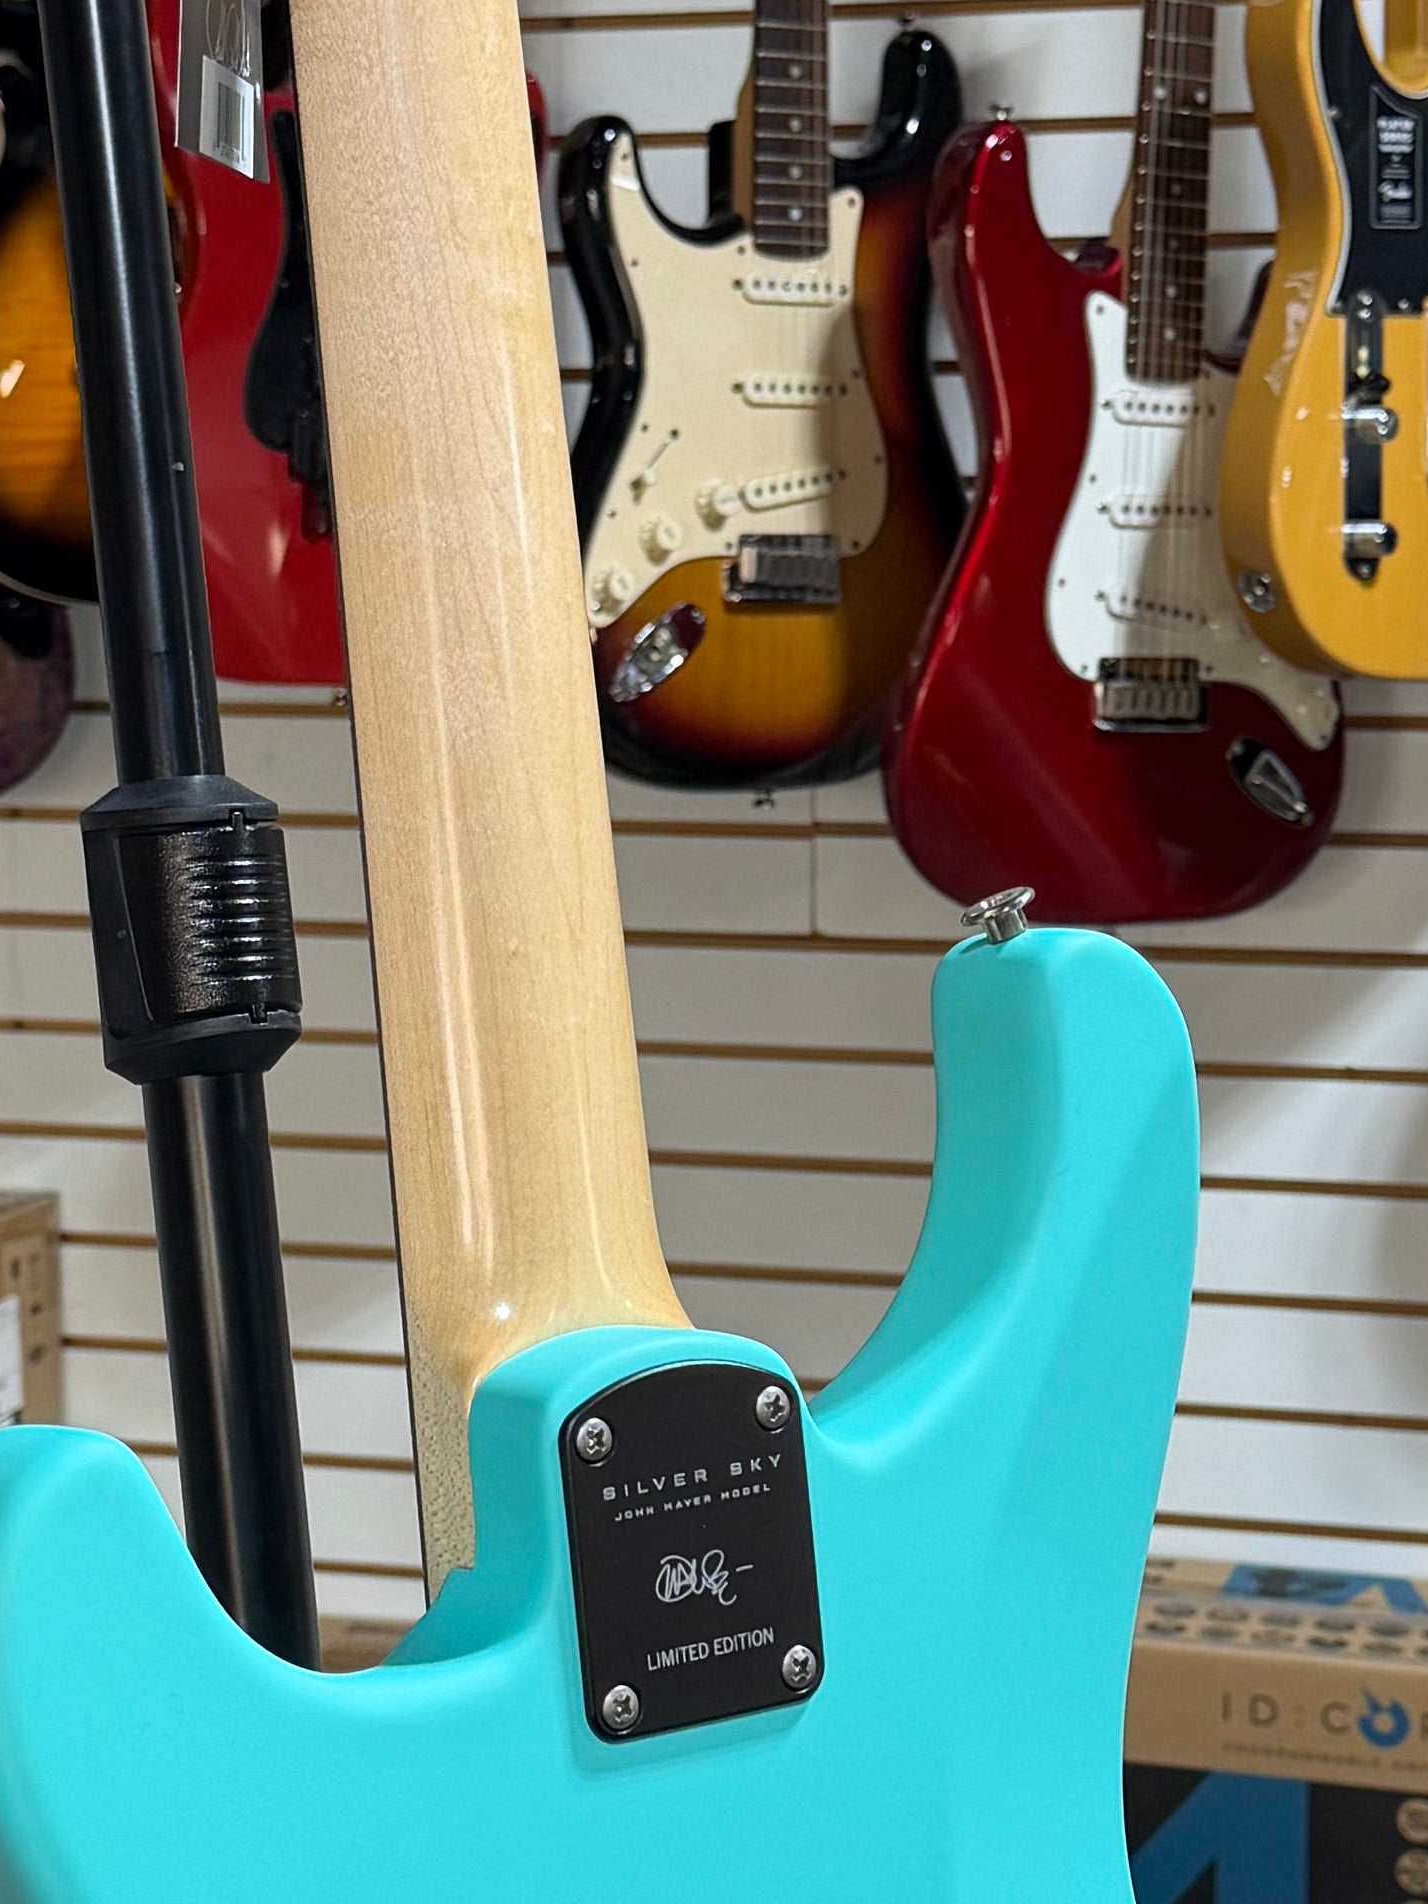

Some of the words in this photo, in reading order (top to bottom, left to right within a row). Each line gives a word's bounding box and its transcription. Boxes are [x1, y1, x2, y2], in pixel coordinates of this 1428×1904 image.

[602, 1468, 709, 1502] SILVER
[728, 1453, 782, 1477] SKY
[614, 1505, 655, 1523] JOHN
[663, 1494, 712, 1513] MAYER
[720, 1482, 772, 1502] MODEL
[646, 1641, 710, 1672] LIMITED
[713, 1625, 775, 1656] EDITION
